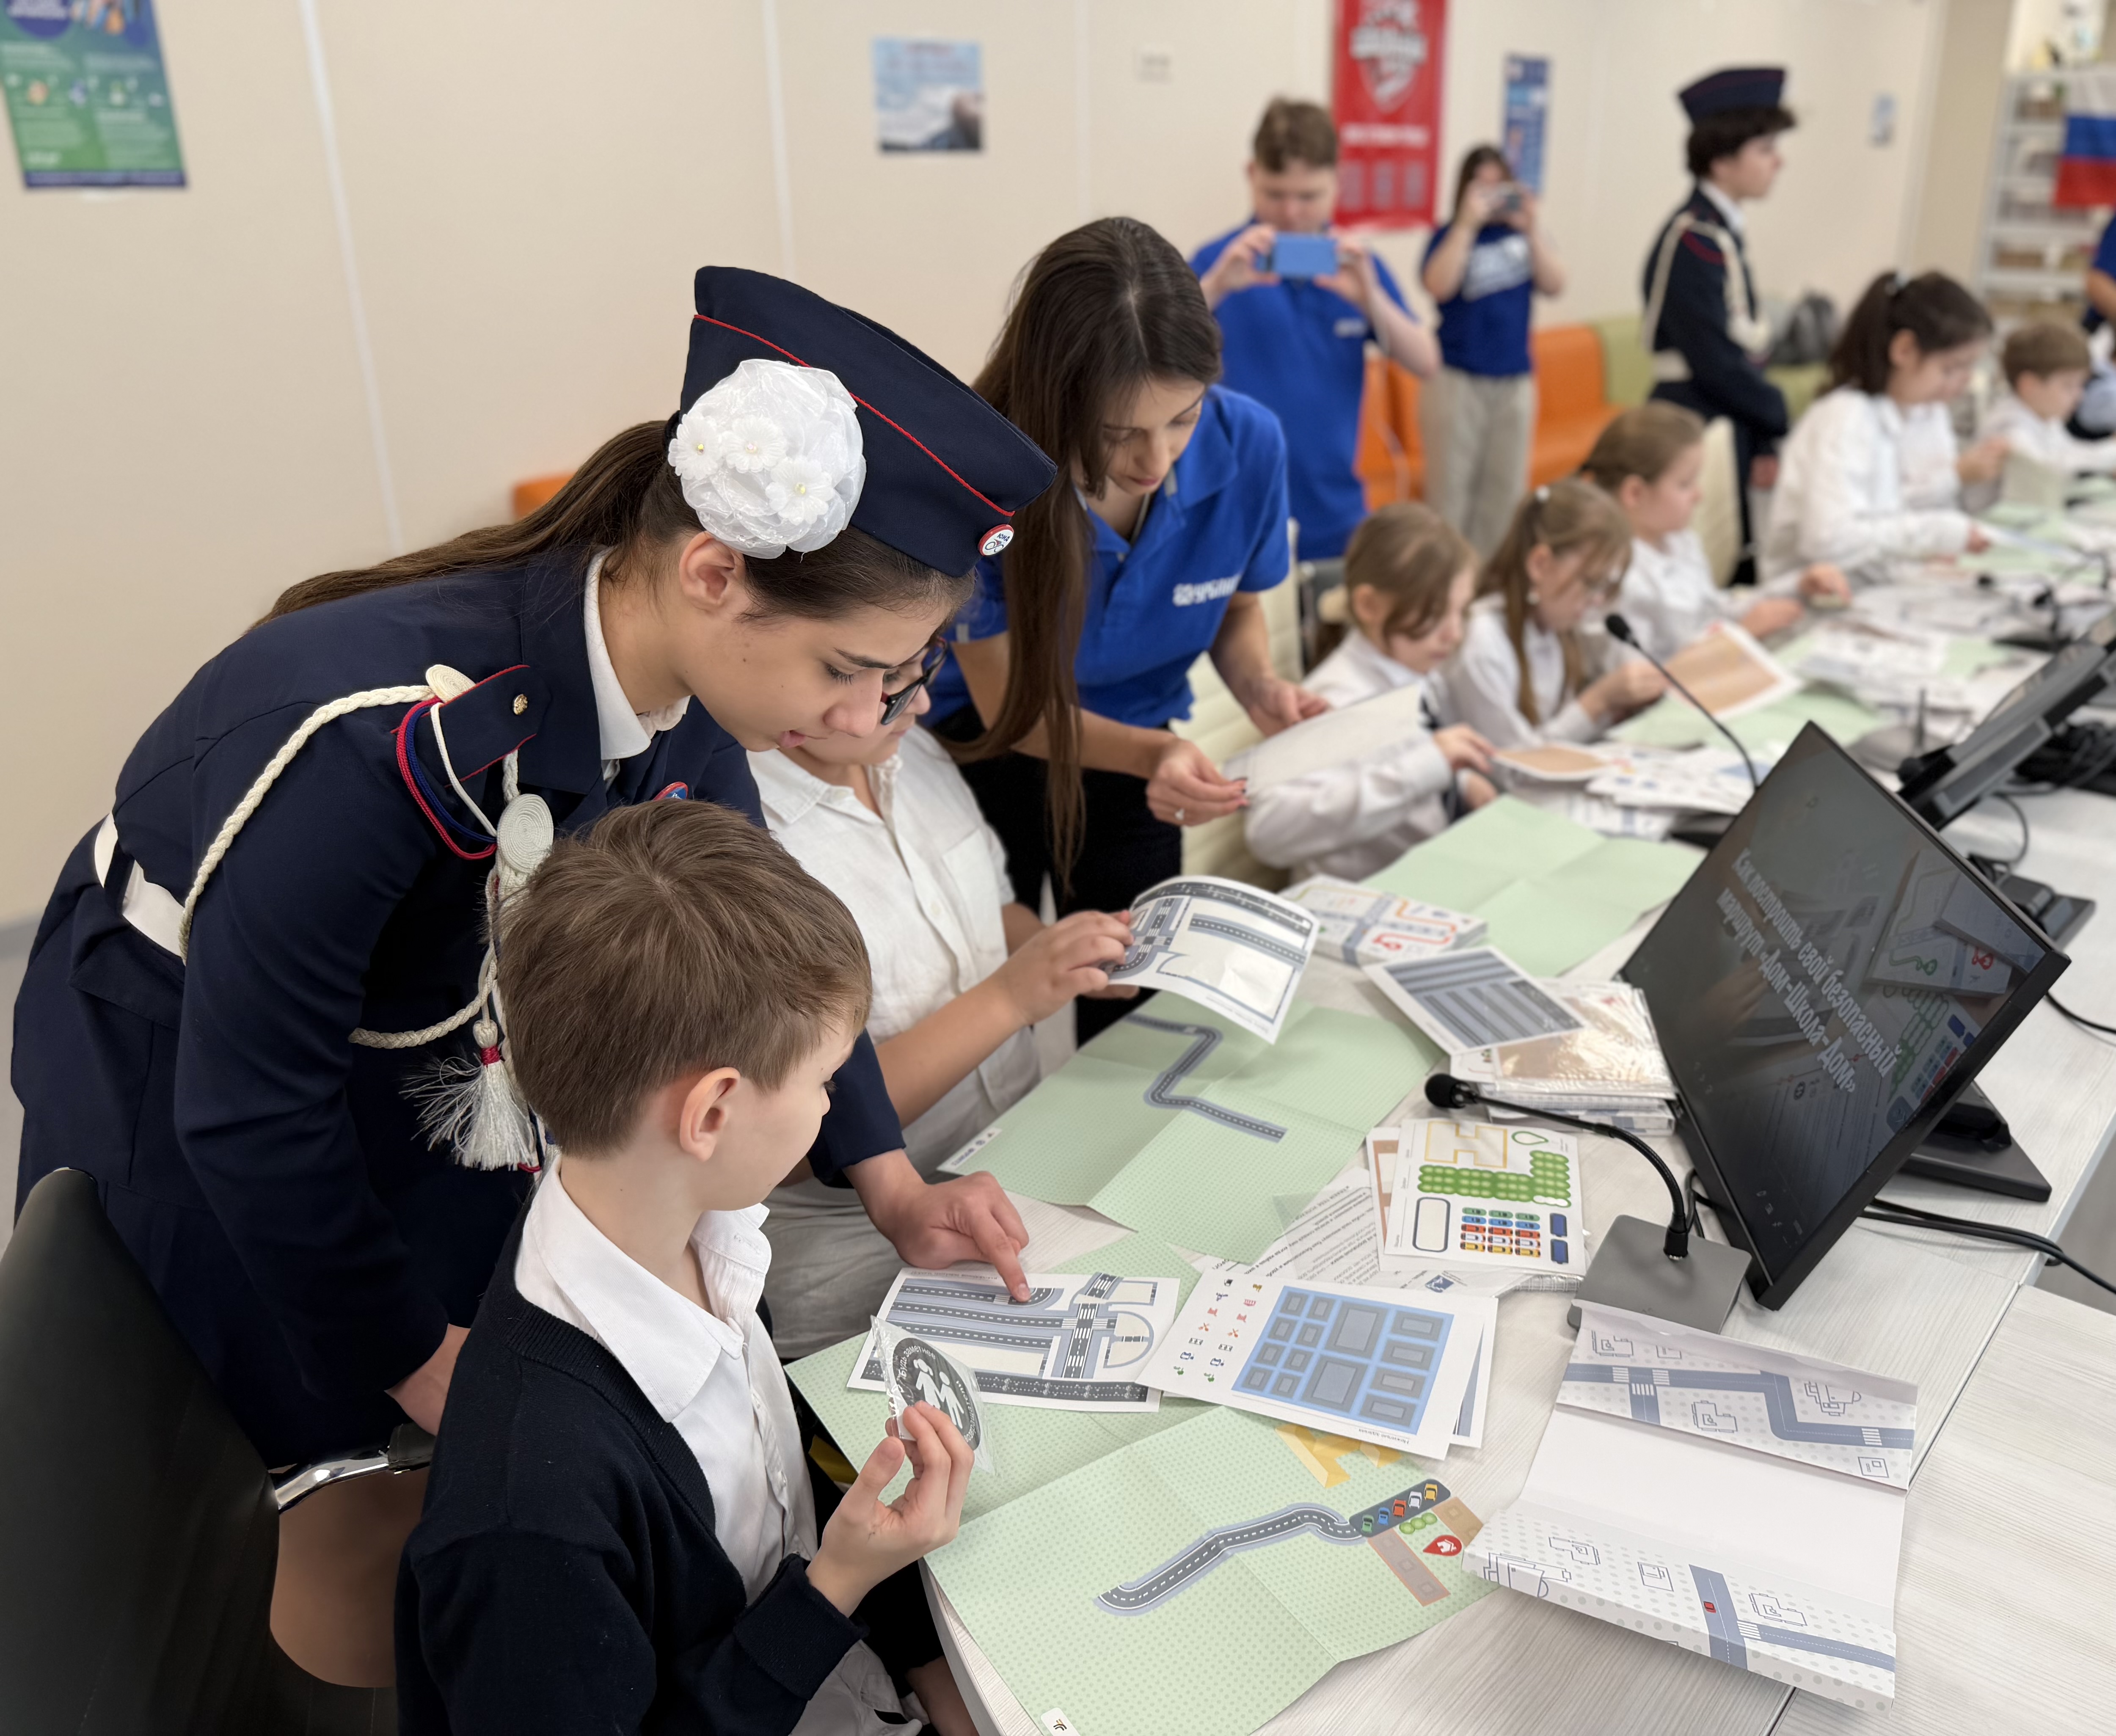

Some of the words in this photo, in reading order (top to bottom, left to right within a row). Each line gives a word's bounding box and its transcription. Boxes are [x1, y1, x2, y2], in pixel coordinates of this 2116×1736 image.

[1716, 887, 1765, 956] маршрут
[1758, 948, 1855, 1093] «Дом-Школа-Дом»
[1732, 847, 1756, 884] Как
[1747, 873, 1803, 950] построить
[1797, 941, 1834, 984] свой
[1821, 969, 1902, 1078] безопасный
[898, 1356, 908, 1380] Будь
[904, 1345, 936, 1360] заметнее
